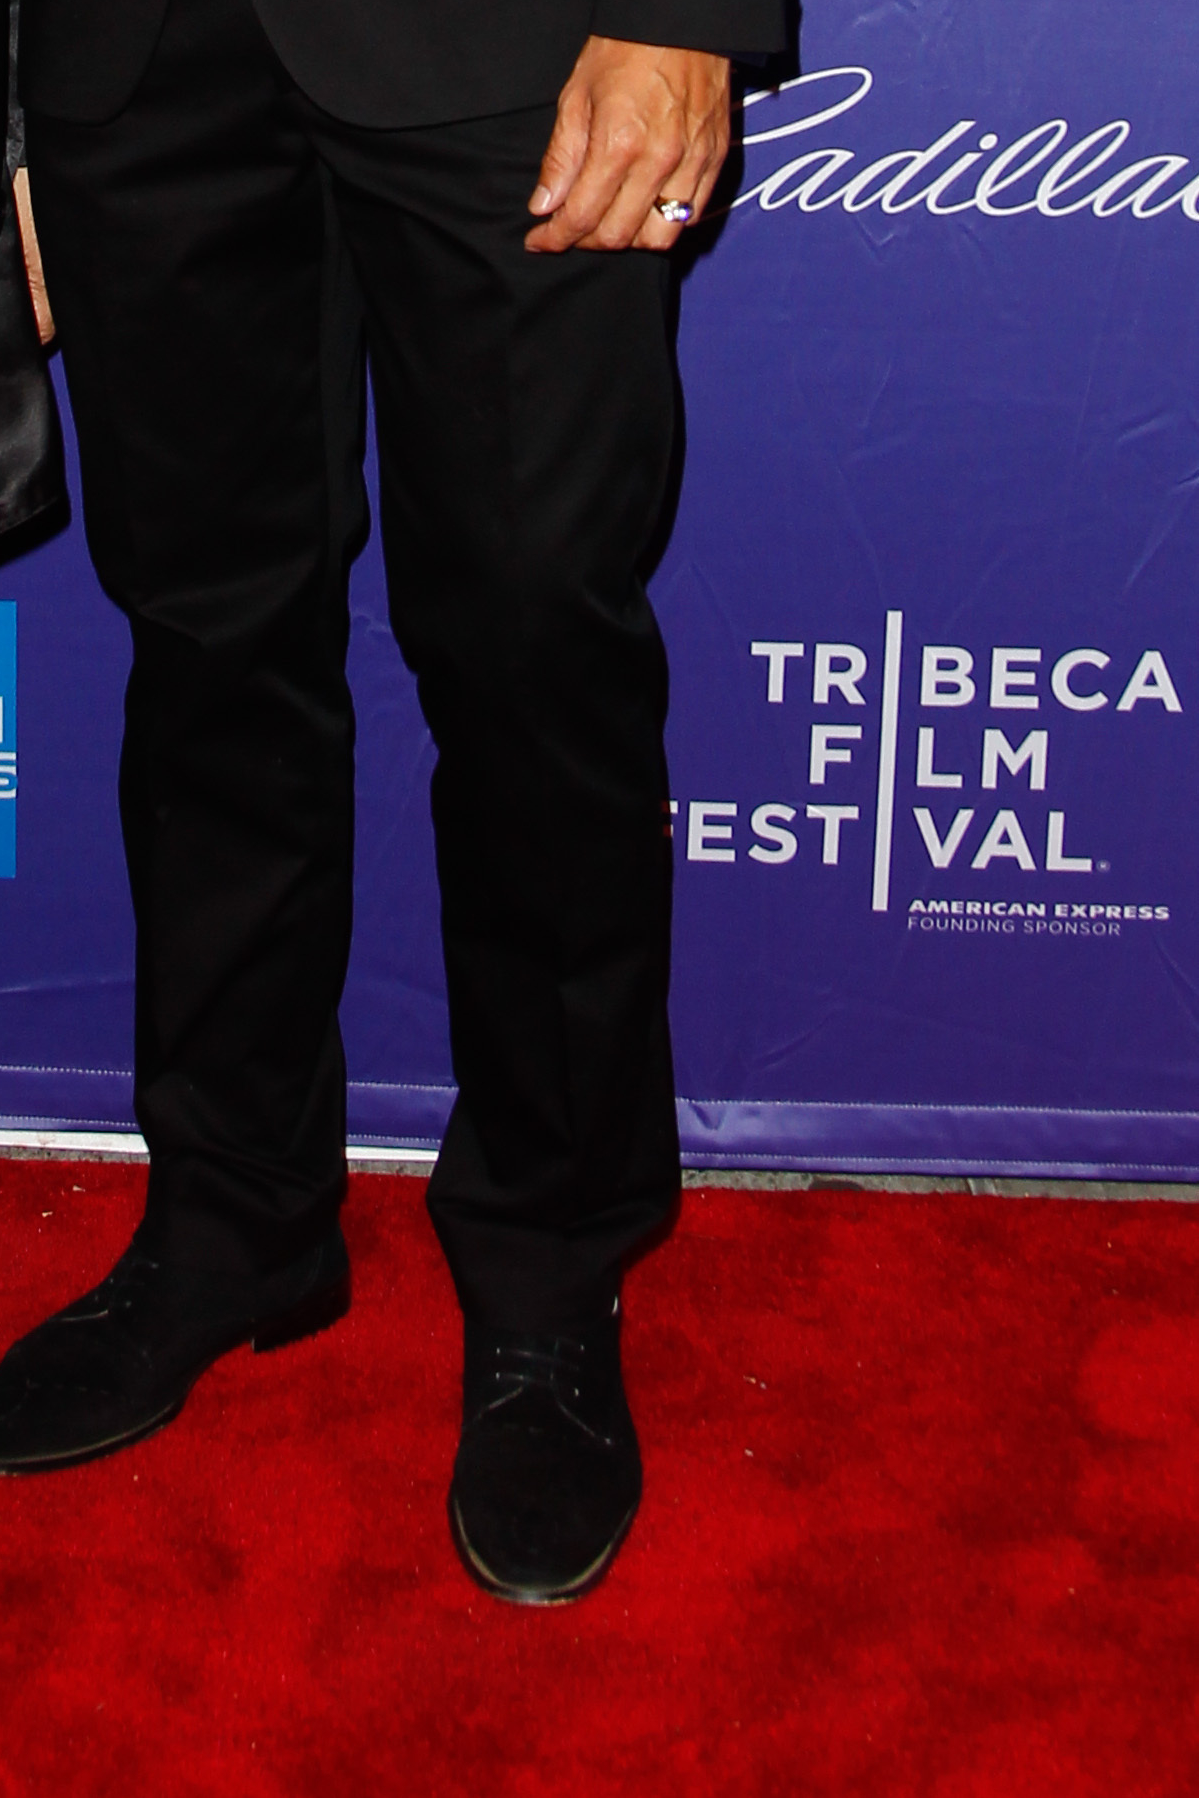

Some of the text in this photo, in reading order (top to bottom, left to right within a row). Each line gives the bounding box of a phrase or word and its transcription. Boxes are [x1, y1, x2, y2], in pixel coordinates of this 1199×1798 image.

[733, 66, 1199, 222] Cadilla
[908, 899, 1170, 921] AMERICAN EXPRESS
[907, 916, 1122, 937] FOUNDING SPONSOR
